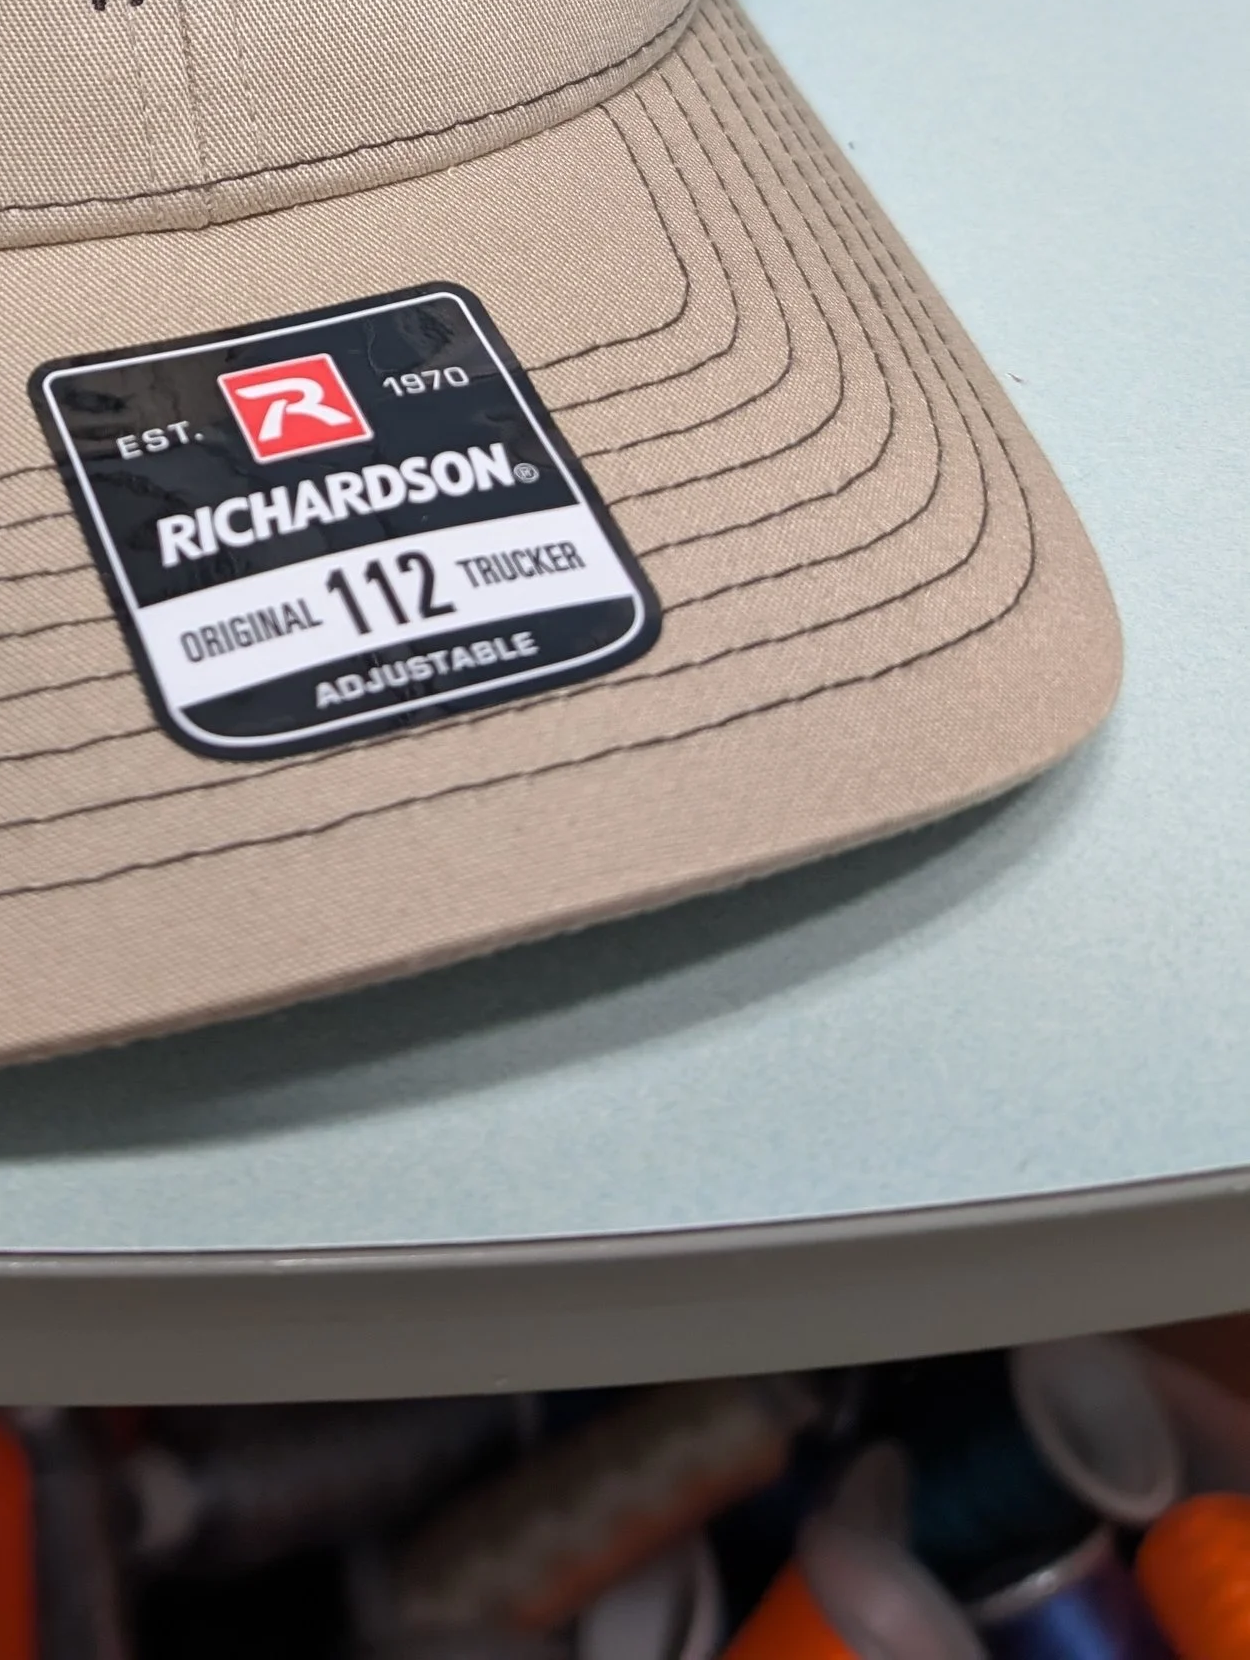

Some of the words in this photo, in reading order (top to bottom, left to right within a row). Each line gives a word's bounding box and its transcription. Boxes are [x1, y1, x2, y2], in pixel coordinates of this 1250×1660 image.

[116, 420, 203, 460] EST.
[382, 366, 470, 397] 1970
[179, 598, 324, 663] ORIGINAL
[325, 550, 457, 637] 112
[456, 541, 587, 589] TRUCKER
[314, 631, 540, 709] ADJUSTABLE
